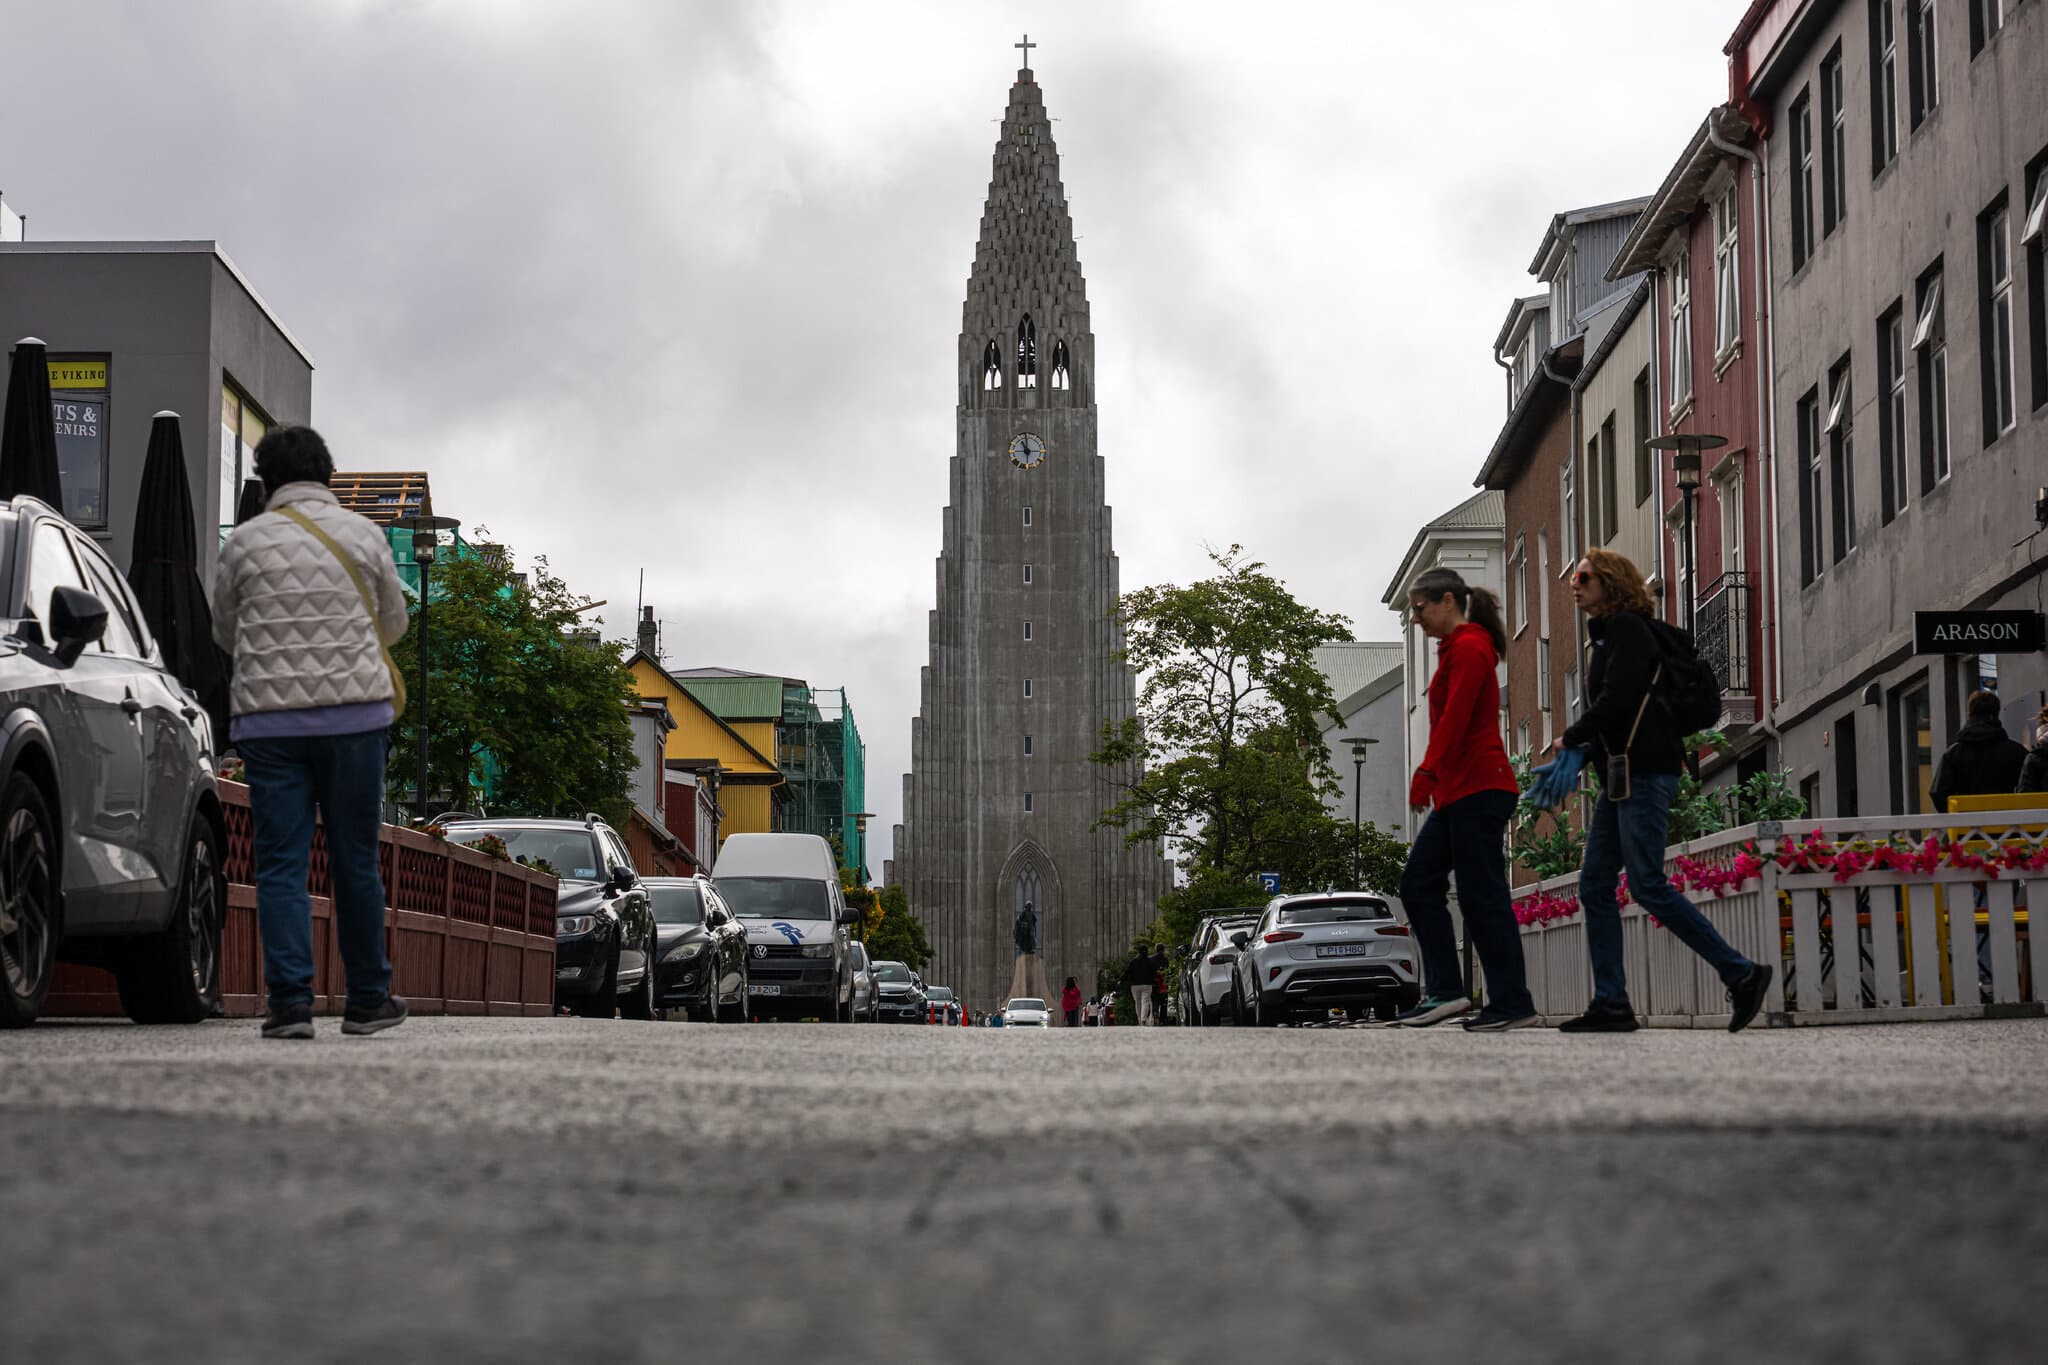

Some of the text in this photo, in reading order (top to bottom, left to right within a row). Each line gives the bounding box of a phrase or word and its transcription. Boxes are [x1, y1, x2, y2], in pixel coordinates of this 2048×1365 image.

[50, 370, 105, 381] E VIKING
[53, 404, 97, 423] TS &
[55, 423, 97, 437] ENIRS
[1932, 623, 2020, 641] ARASON
